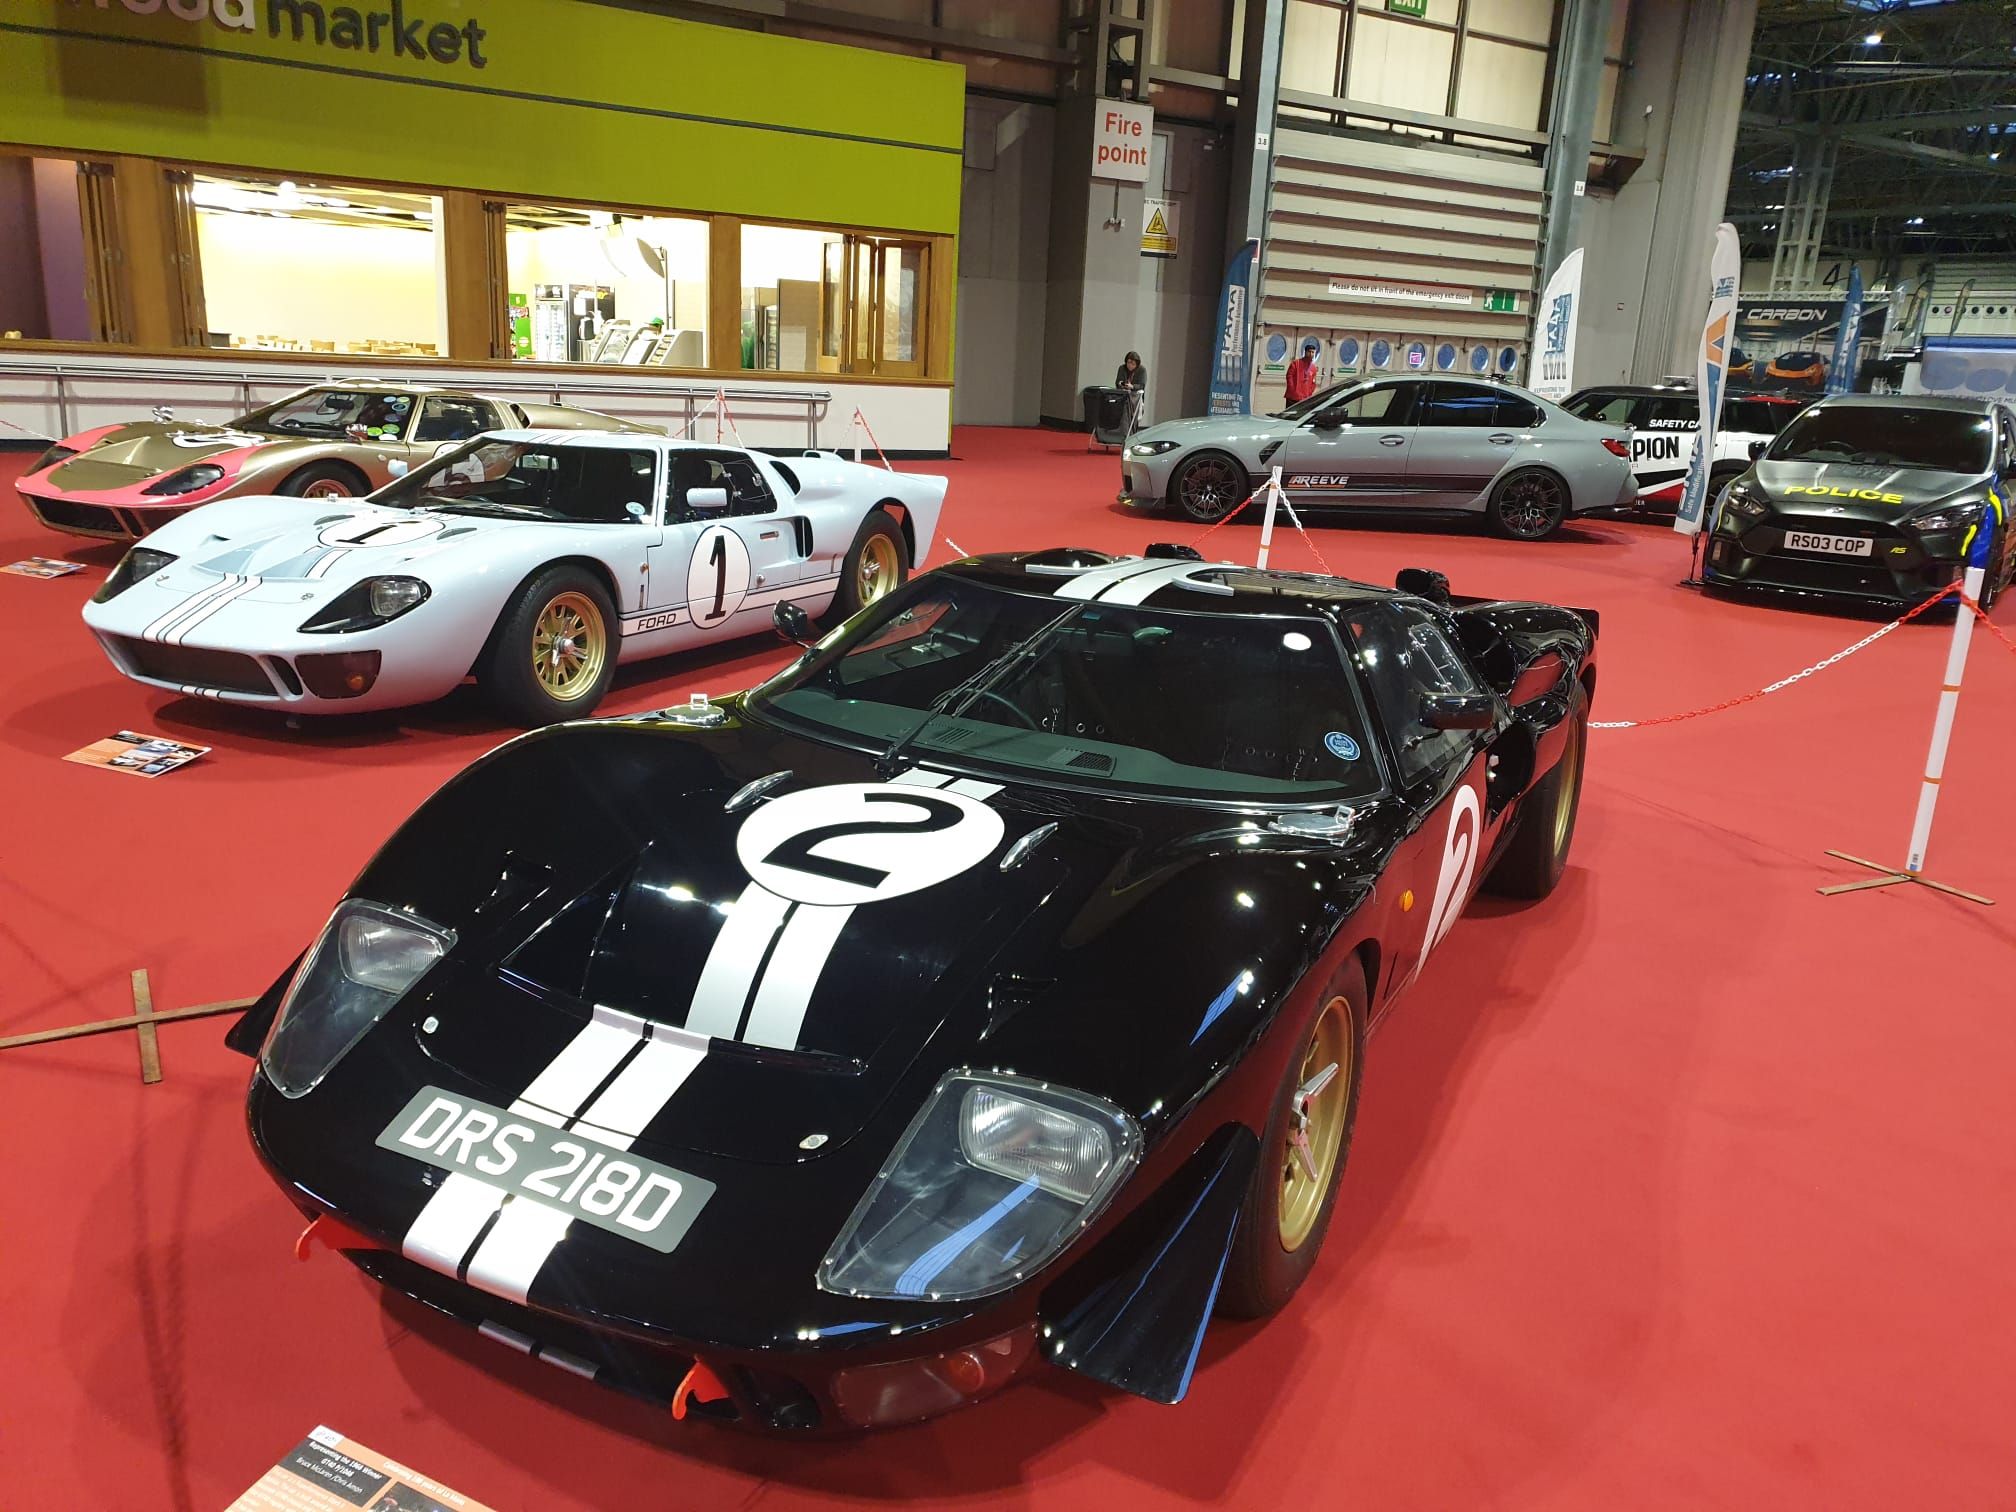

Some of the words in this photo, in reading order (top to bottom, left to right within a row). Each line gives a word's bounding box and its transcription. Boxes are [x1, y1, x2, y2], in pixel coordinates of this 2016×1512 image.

[267, 0, 487, 68] market
[1105, 111, 1142, 136] Fire
[1097, 143, 1148, 165] point
[1332, 282, 1350, 290] Please
[1385, 286, 1398, 294] front
[1415, 290, 1444, 300] emergency
[1747, 308, 1828, 321] CARBON
[1649, 419, 1687, 429] SAFETY
[1629, 436, 1680, 463] PION
[1784, 485, 1905, 504] POLICE
[335, 520, 422, 545] 1
[1791, 534, 1830, 550] RS03
[1834, 539, 1866, 553] COP
[704, 535, 726, 621] 1
[637, 612, 677, 631] FORD
[761, 792, 964, 889] 2
[398, 1096, 535, 1176] DRS
[520, 1141, 683, 1233] 218D
[308, 1441, 341, 1460] Representing
[340, 1456, 351, 1464] the
[361, 1467, 383, 1480] Winner
[296, 1457, 312, 1468] Bruce
[310, 1465, 334, 1479] McLaren
[346, 1482, 363, 1493] Amon
